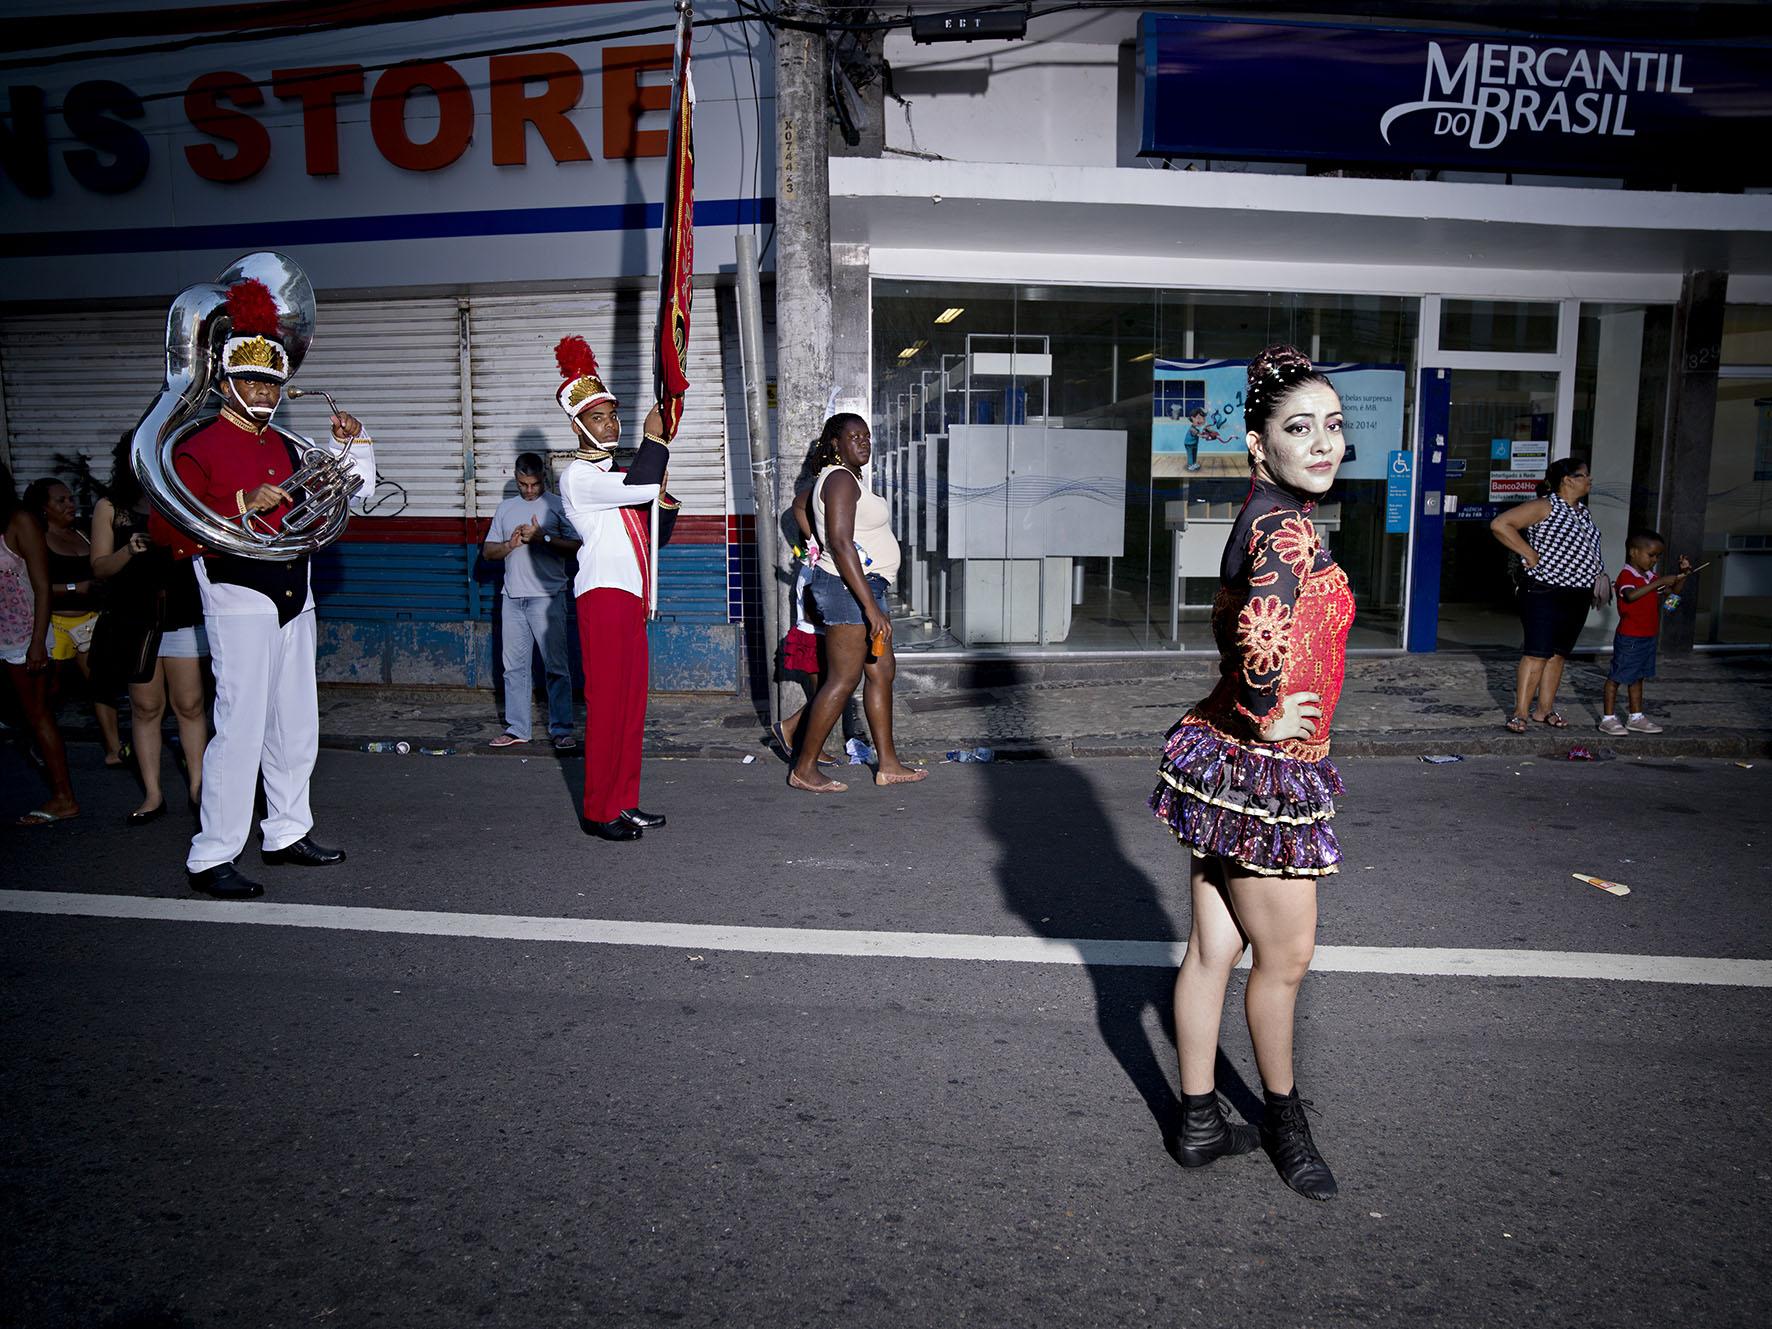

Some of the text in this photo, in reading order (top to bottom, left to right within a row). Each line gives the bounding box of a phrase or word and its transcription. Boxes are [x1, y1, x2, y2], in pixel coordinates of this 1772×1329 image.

[1422, 41, 1694, 104] MERCANTIL
[184, 43, 675, 184] STORE
[1433, 87, 1636, 149] DO BRASIL
[1211, 391, 1245, 430] 201
[1345, 394, 1362, 402] belas
[1363, 395, 1392, 403] surpresas
[1342, 420, 1377, 430] eliz 2014!
[1492, 482, 1536, 491] Banco24Ho
